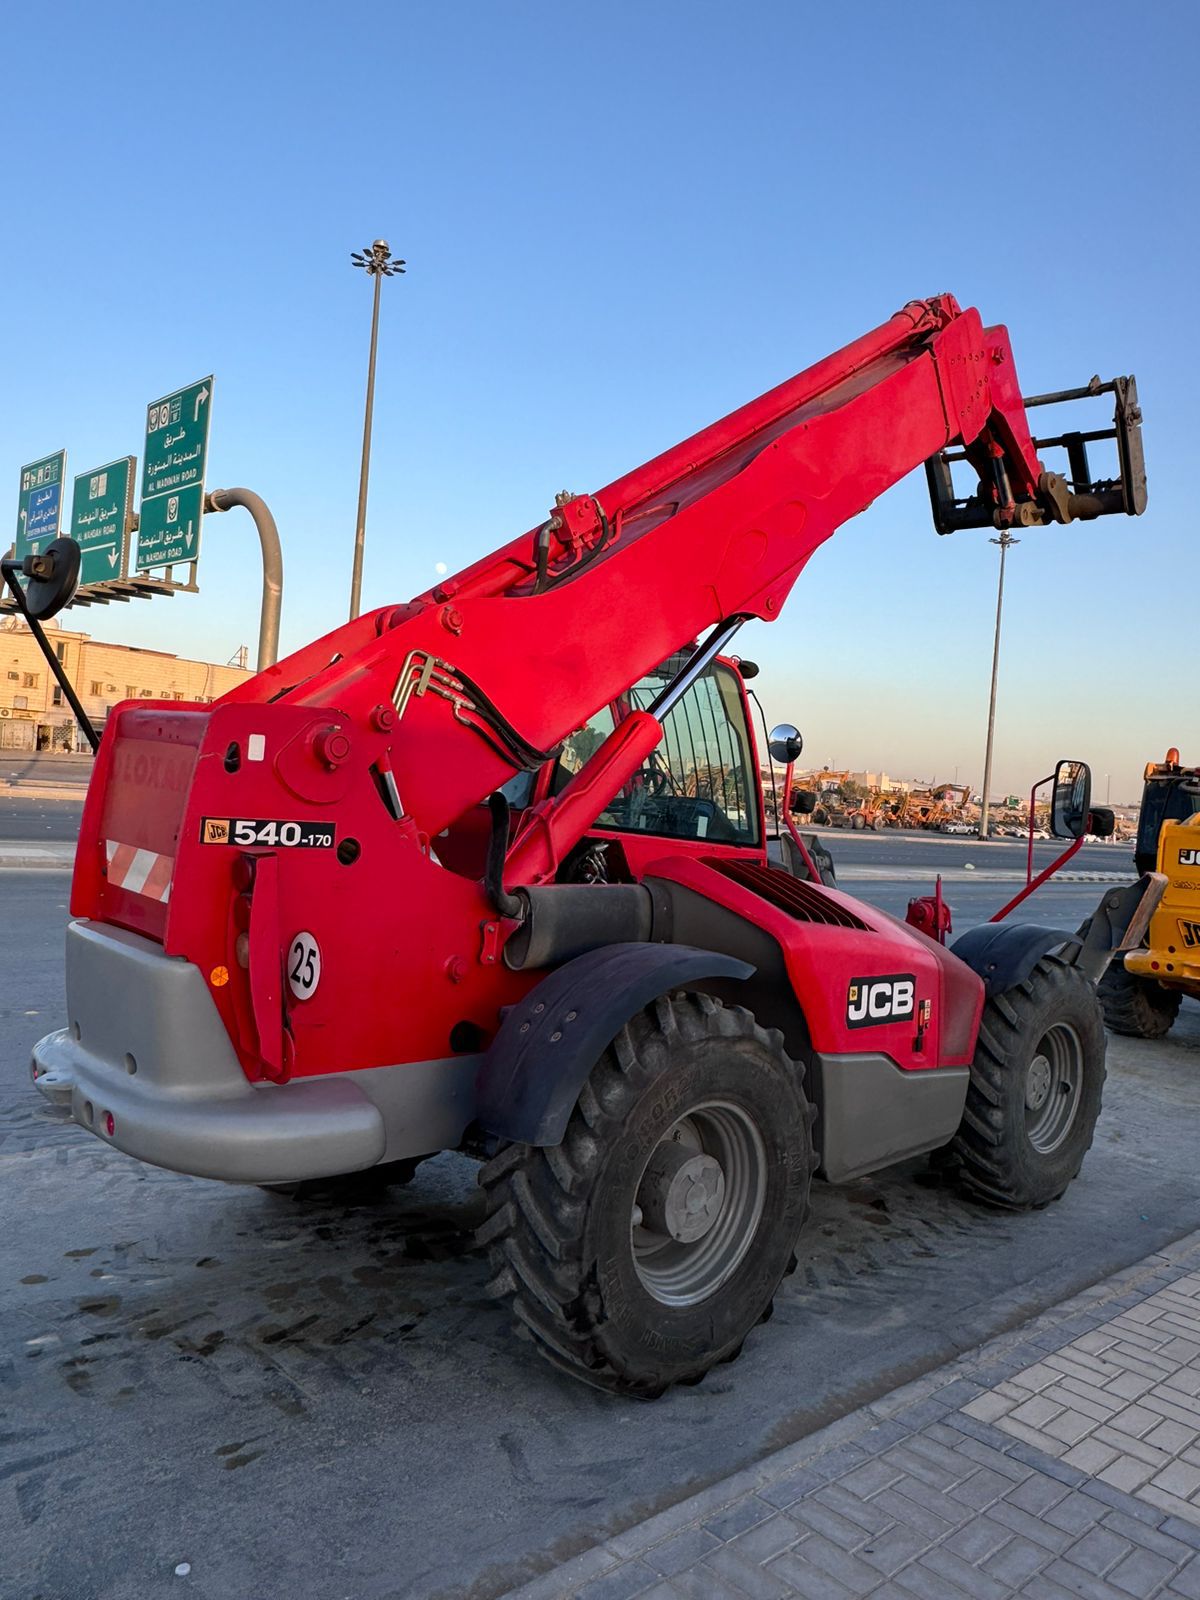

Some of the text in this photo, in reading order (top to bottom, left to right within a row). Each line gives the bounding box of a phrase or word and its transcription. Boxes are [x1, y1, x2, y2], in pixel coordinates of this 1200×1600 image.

[164, 426, 186, 449] طريق
[147, 443, 201, 476] المدينة المنورة
[148, 482, 155, 492] AL
[181, 468, 197, 482] ROAD
[77, 502, 118, 525] طريق النهضة
[103, 523, 116, 535] ROAD
[139, 526, 184, 548] طريق النهضة
[167, 547, 183, 559] ROAD
[208, 820, 332, 847] JCB 540-170
[290, 941, 317, 989] 25
[848, 981, 914, 1021] JCB
